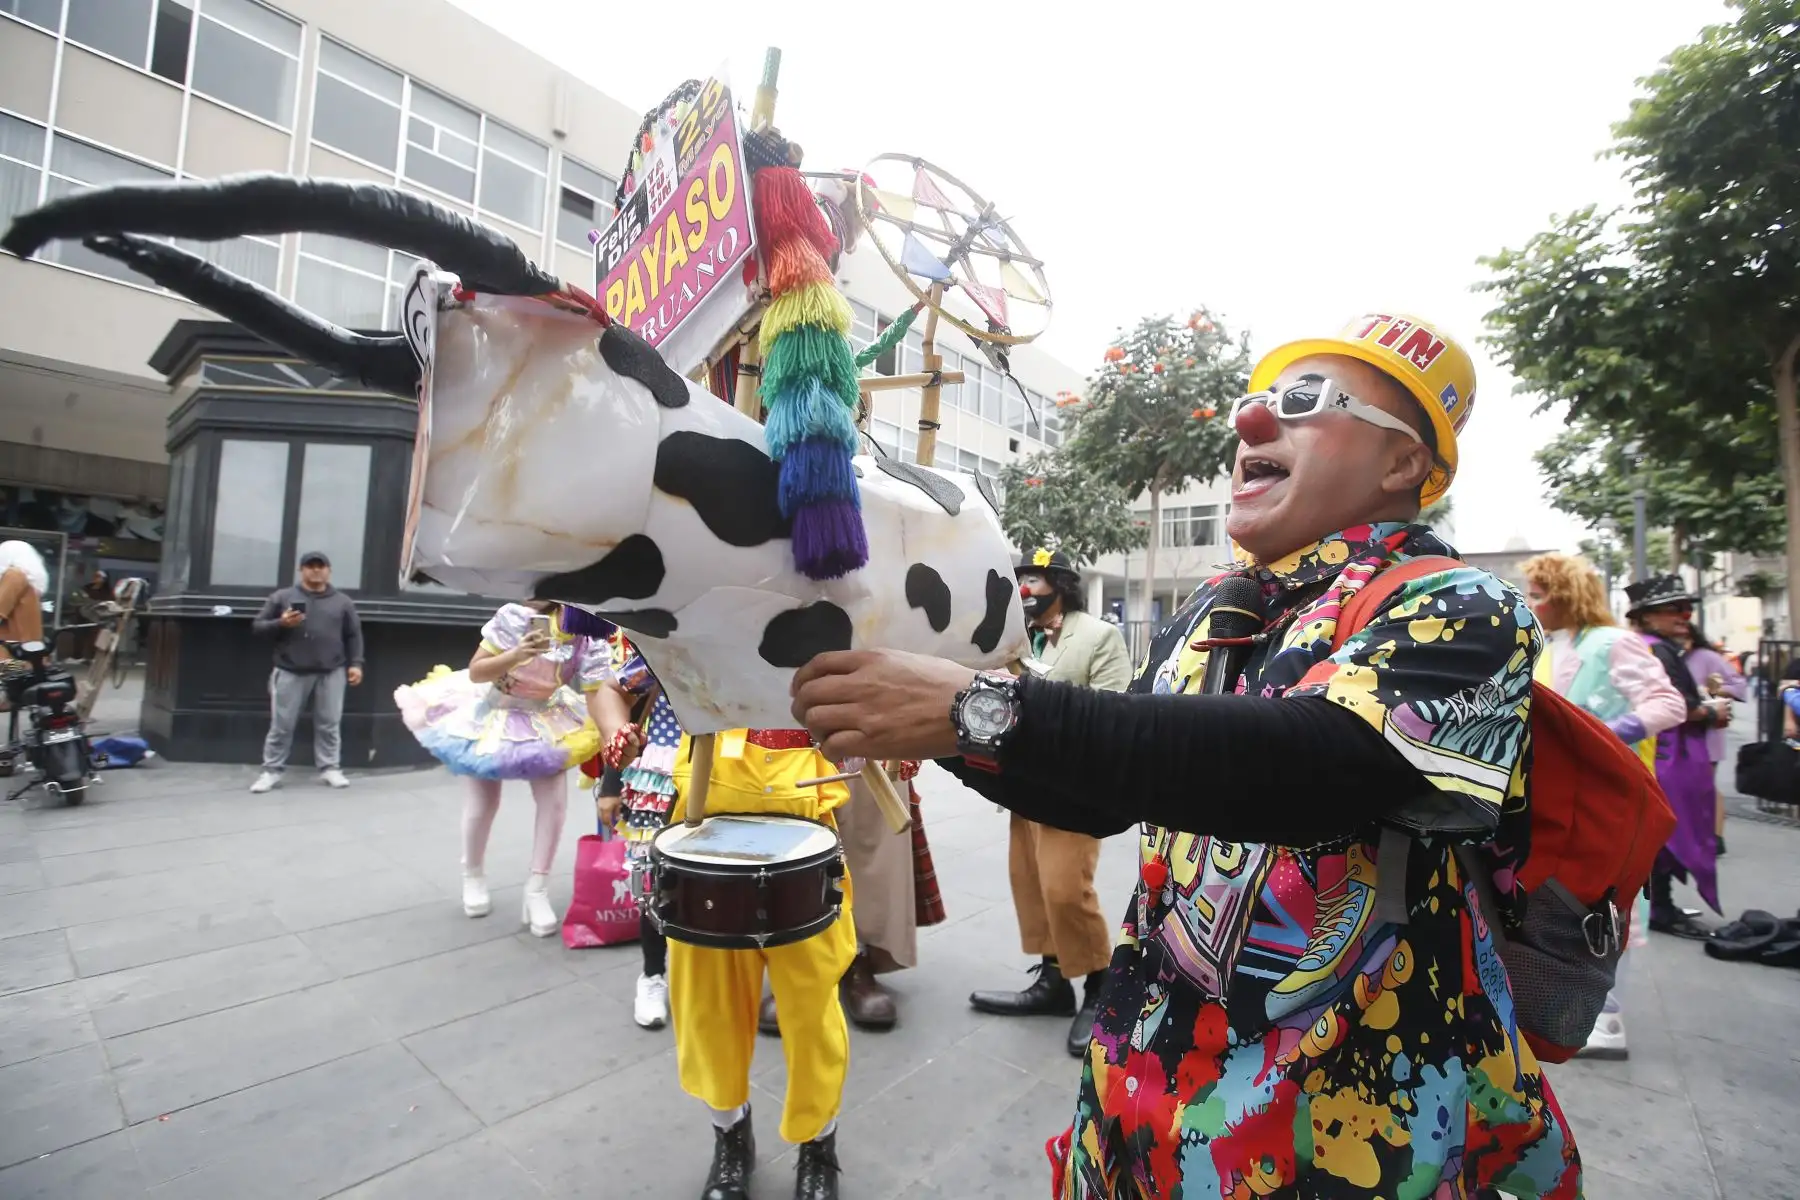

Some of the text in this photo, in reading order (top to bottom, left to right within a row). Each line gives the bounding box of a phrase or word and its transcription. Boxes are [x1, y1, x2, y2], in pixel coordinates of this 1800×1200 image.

[679, 79, 724, 158] 25
[650, 180, 672, 214] TIN
[599, 205, 637, 263] Feliz
[606, 143, 735, 328] PAYASO
[641, 227, 739, 341] RUANO
[1355, 313, 1447, 372] TIN
